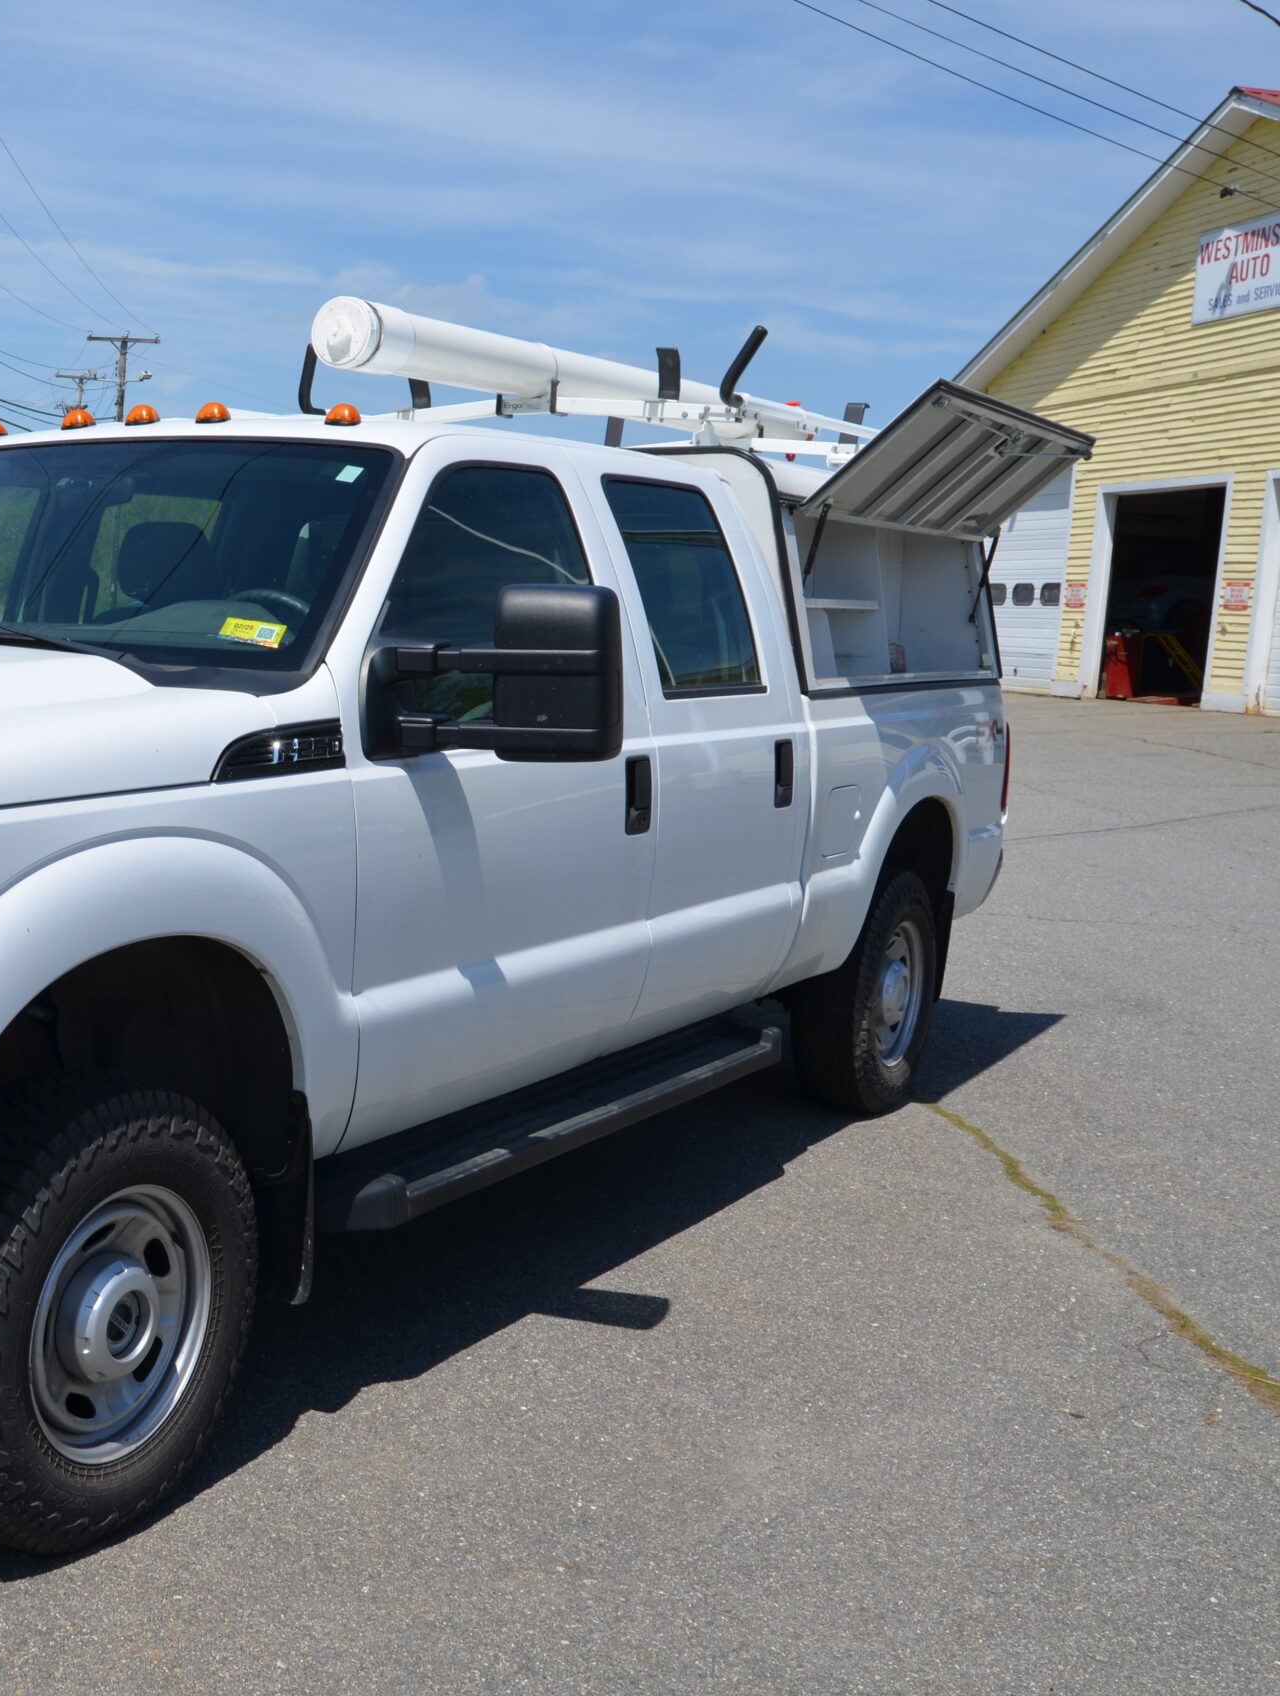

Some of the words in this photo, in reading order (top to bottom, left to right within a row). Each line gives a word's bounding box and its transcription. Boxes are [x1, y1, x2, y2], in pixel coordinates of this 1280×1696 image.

[1200, 223, 1280, 266] WESTMINS
[1228, 253, 1270, 285] AUTO
[1208, 294, 1232, 311] SALES
[1236, 289, 1250, 304] and
